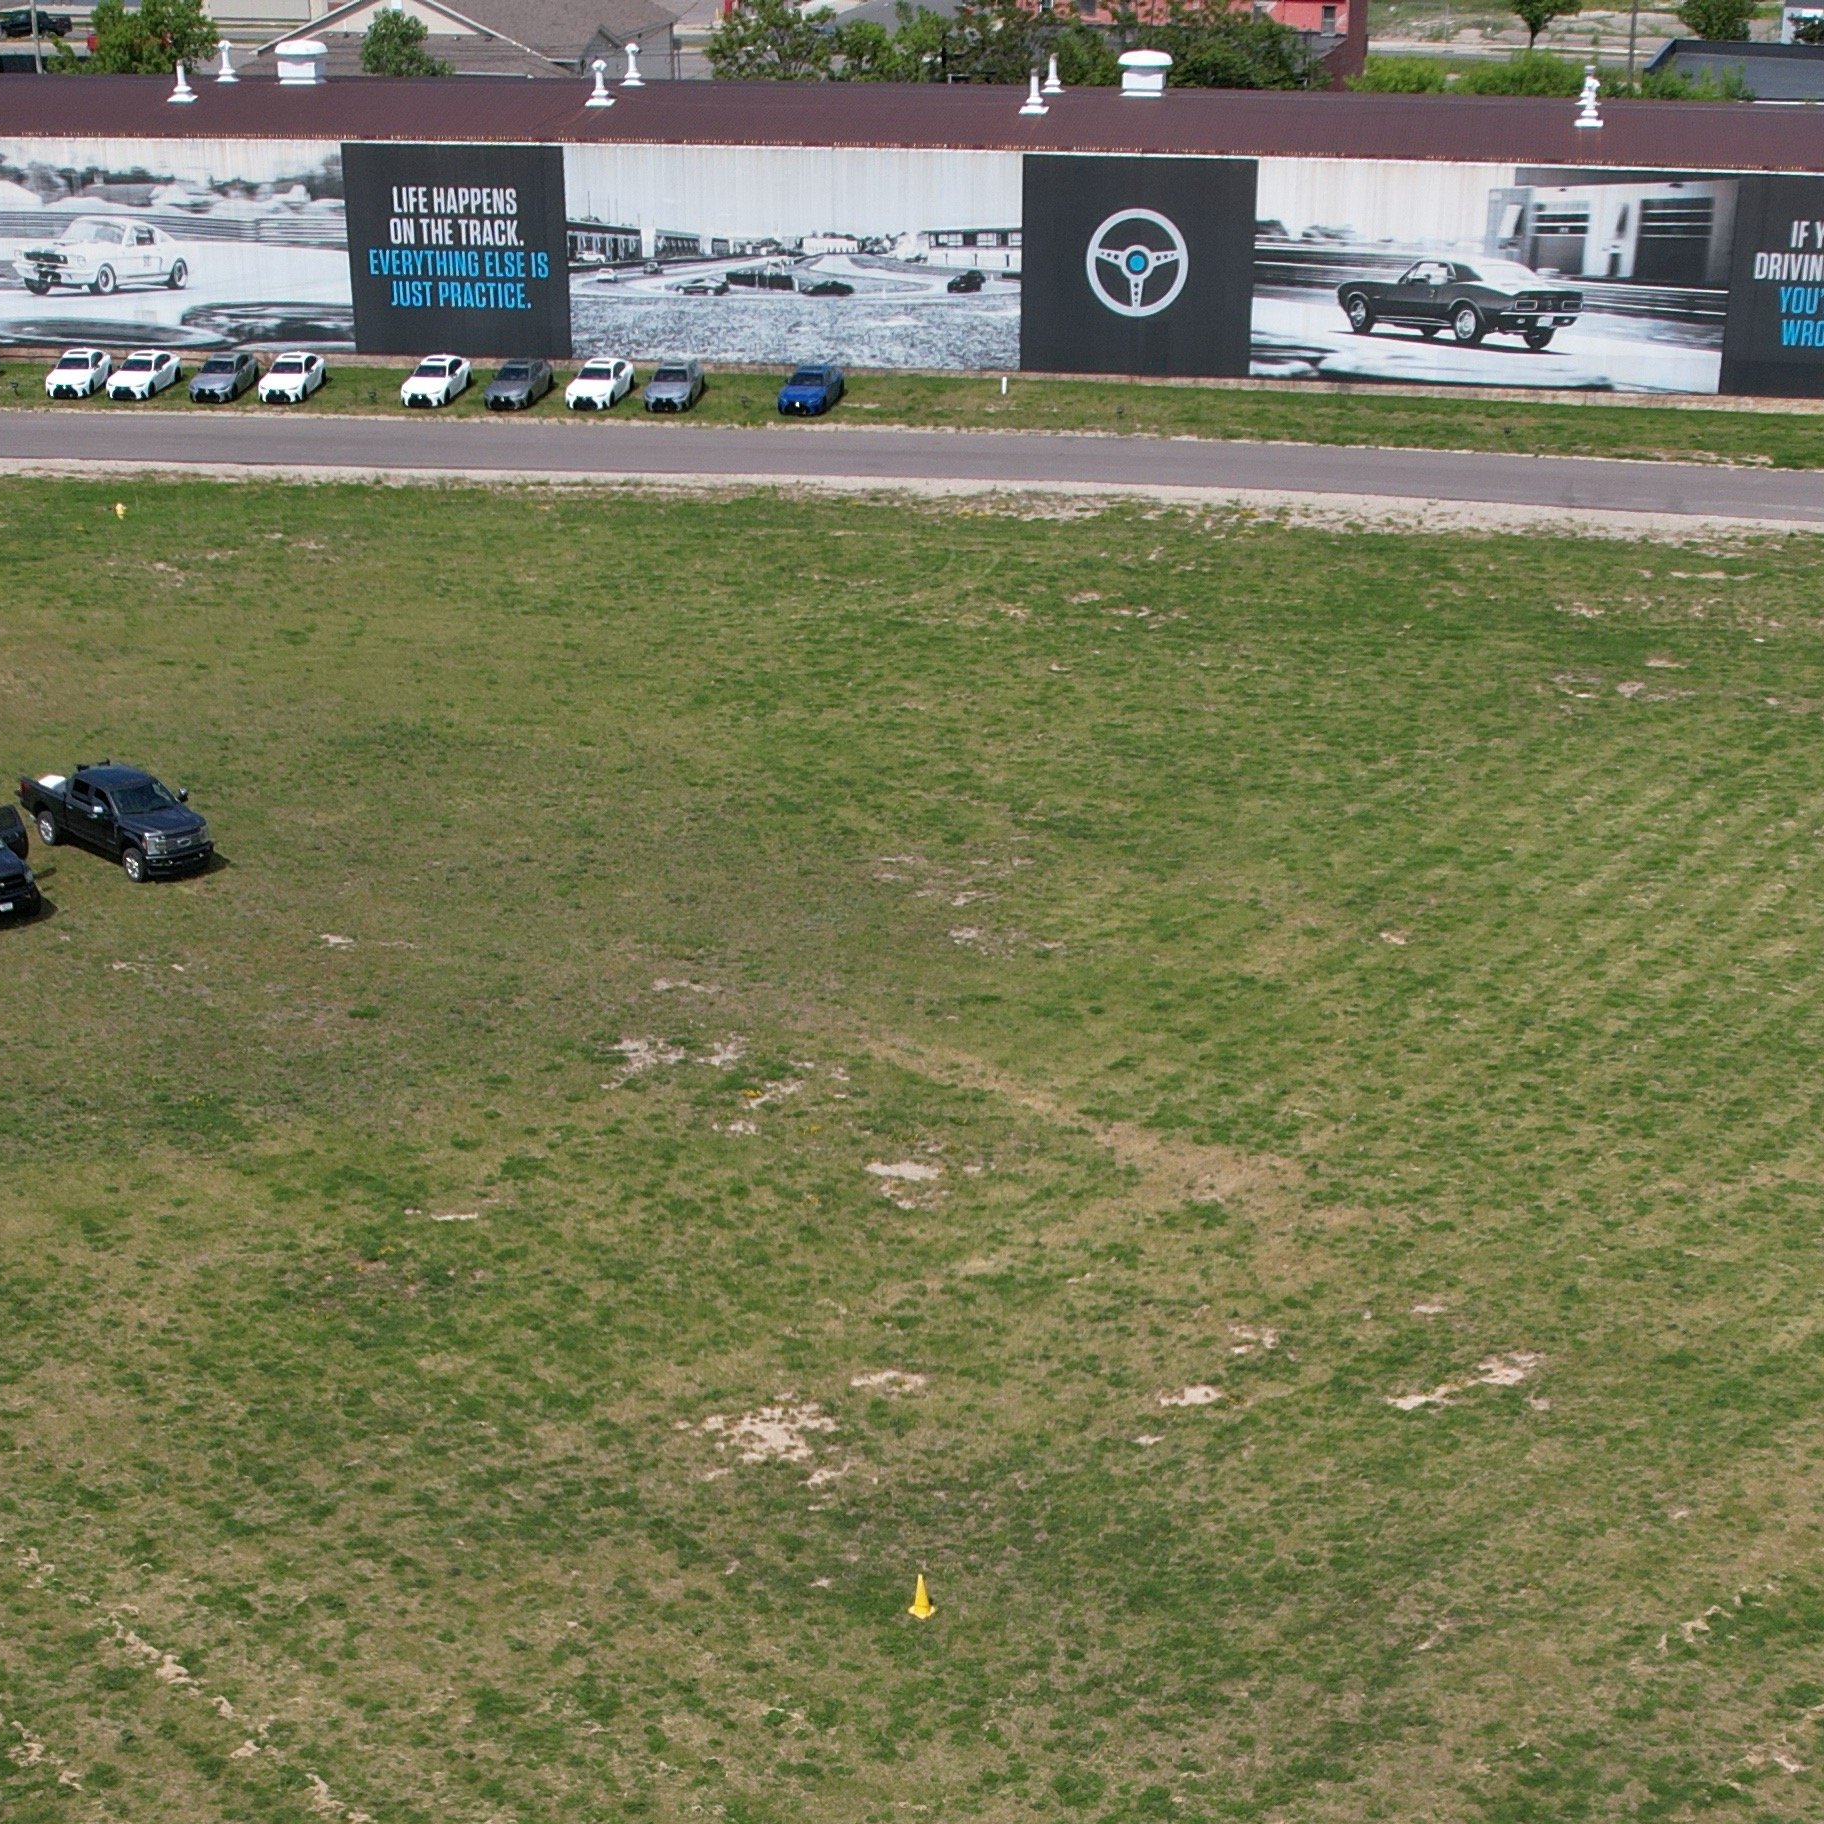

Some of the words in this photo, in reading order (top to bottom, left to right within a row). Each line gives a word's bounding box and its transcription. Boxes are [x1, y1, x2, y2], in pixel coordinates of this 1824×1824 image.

[392, 186, 428, 213] LIFE
[433, 187, 517, 215] HAPPENS
[389, 217, 415, 245] ON
[419, 218, 454, 246] THE
[458, 219, 525, 247] TRACK.
[1790, 220, 1810, 248] IF
[369, 248, 479, 277] EVERYTHING
[484, 251, 526, 278] ELSE
[530, 252, 549, 279] IS
[391, 281, 432, 307] JUST
[438, 281, 532, 309] PRACTICE.
